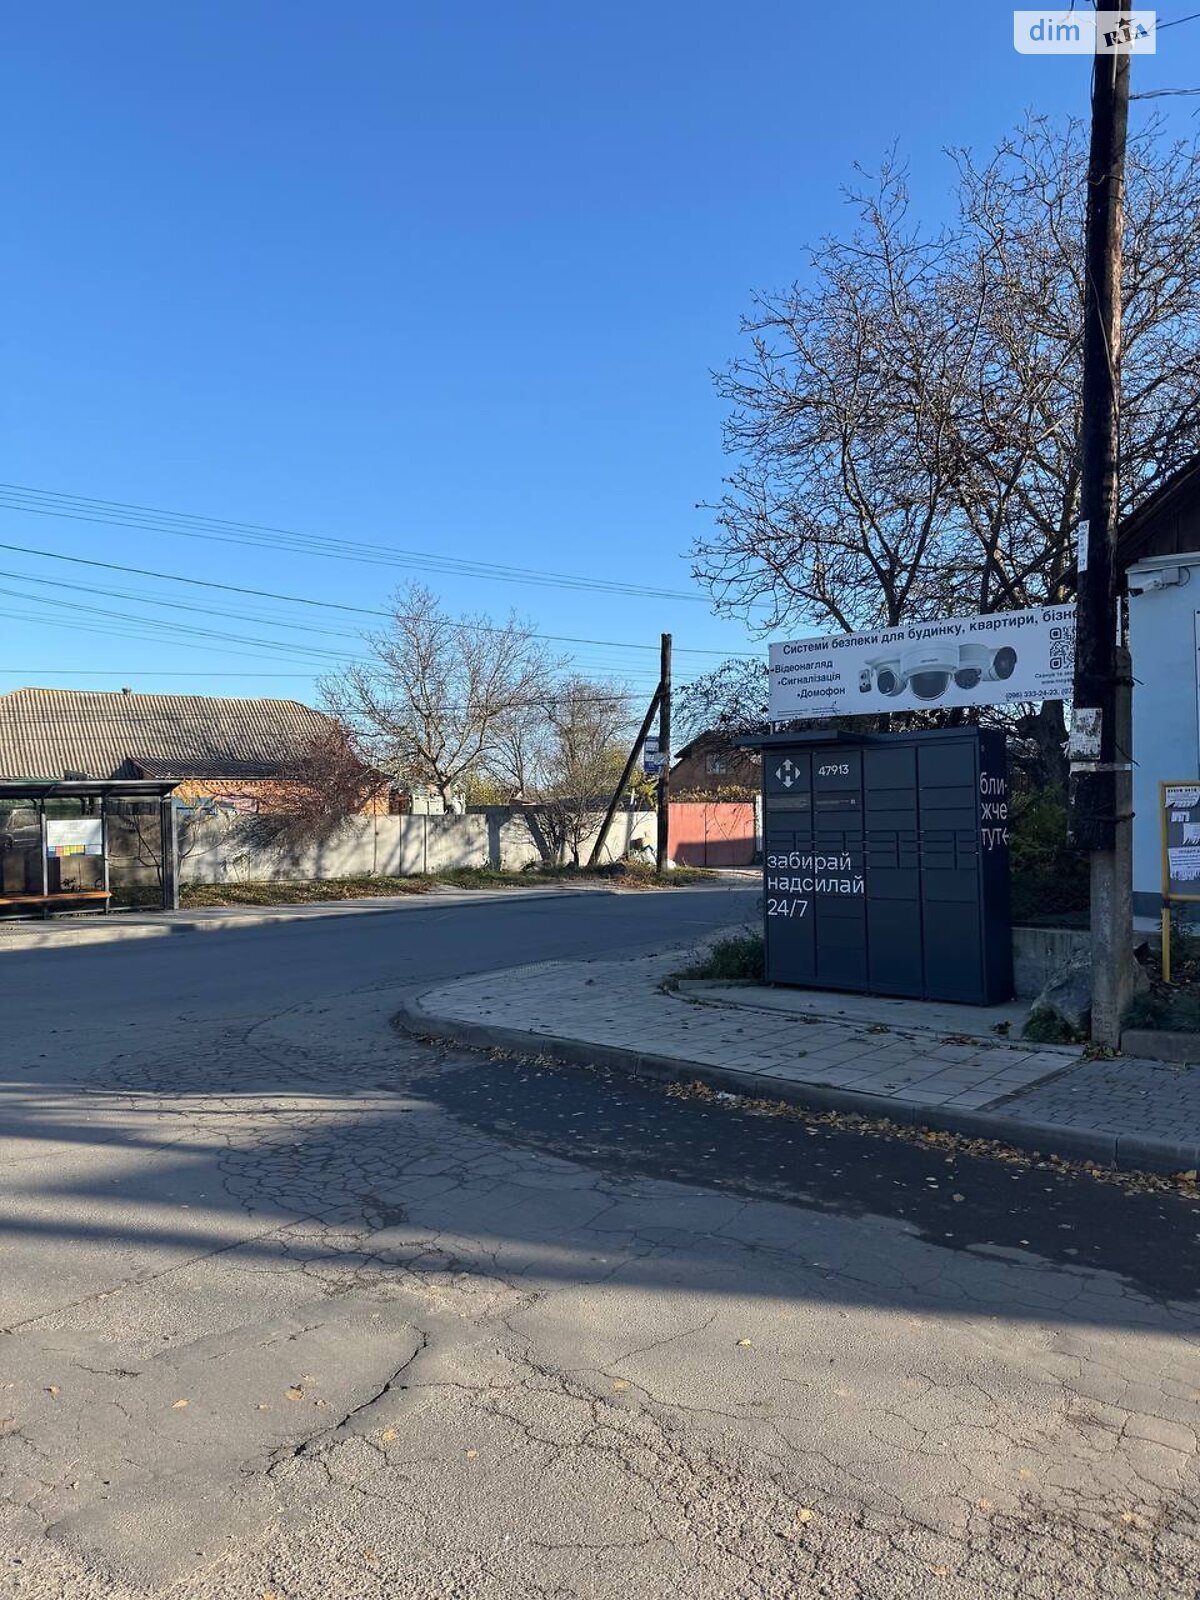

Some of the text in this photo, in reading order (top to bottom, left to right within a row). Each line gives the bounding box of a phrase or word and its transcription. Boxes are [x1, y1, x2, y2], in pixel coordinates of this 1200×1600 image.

[783, 642, 829, 655] Системи
[831, 637, 879, 649] безпеки
[881, 631, 905, 645] для
[908, 622, 966, 641] будинку,
[969, 613, 1039, 632] квартири,
[818, 764, 850, 776] 47913
[981, 802, 1009, 820] жче
[767, 852, 852, 874] забирай
[767, 874, 865, 894] надсилай
[767, 899, 808, 917] 24/7
